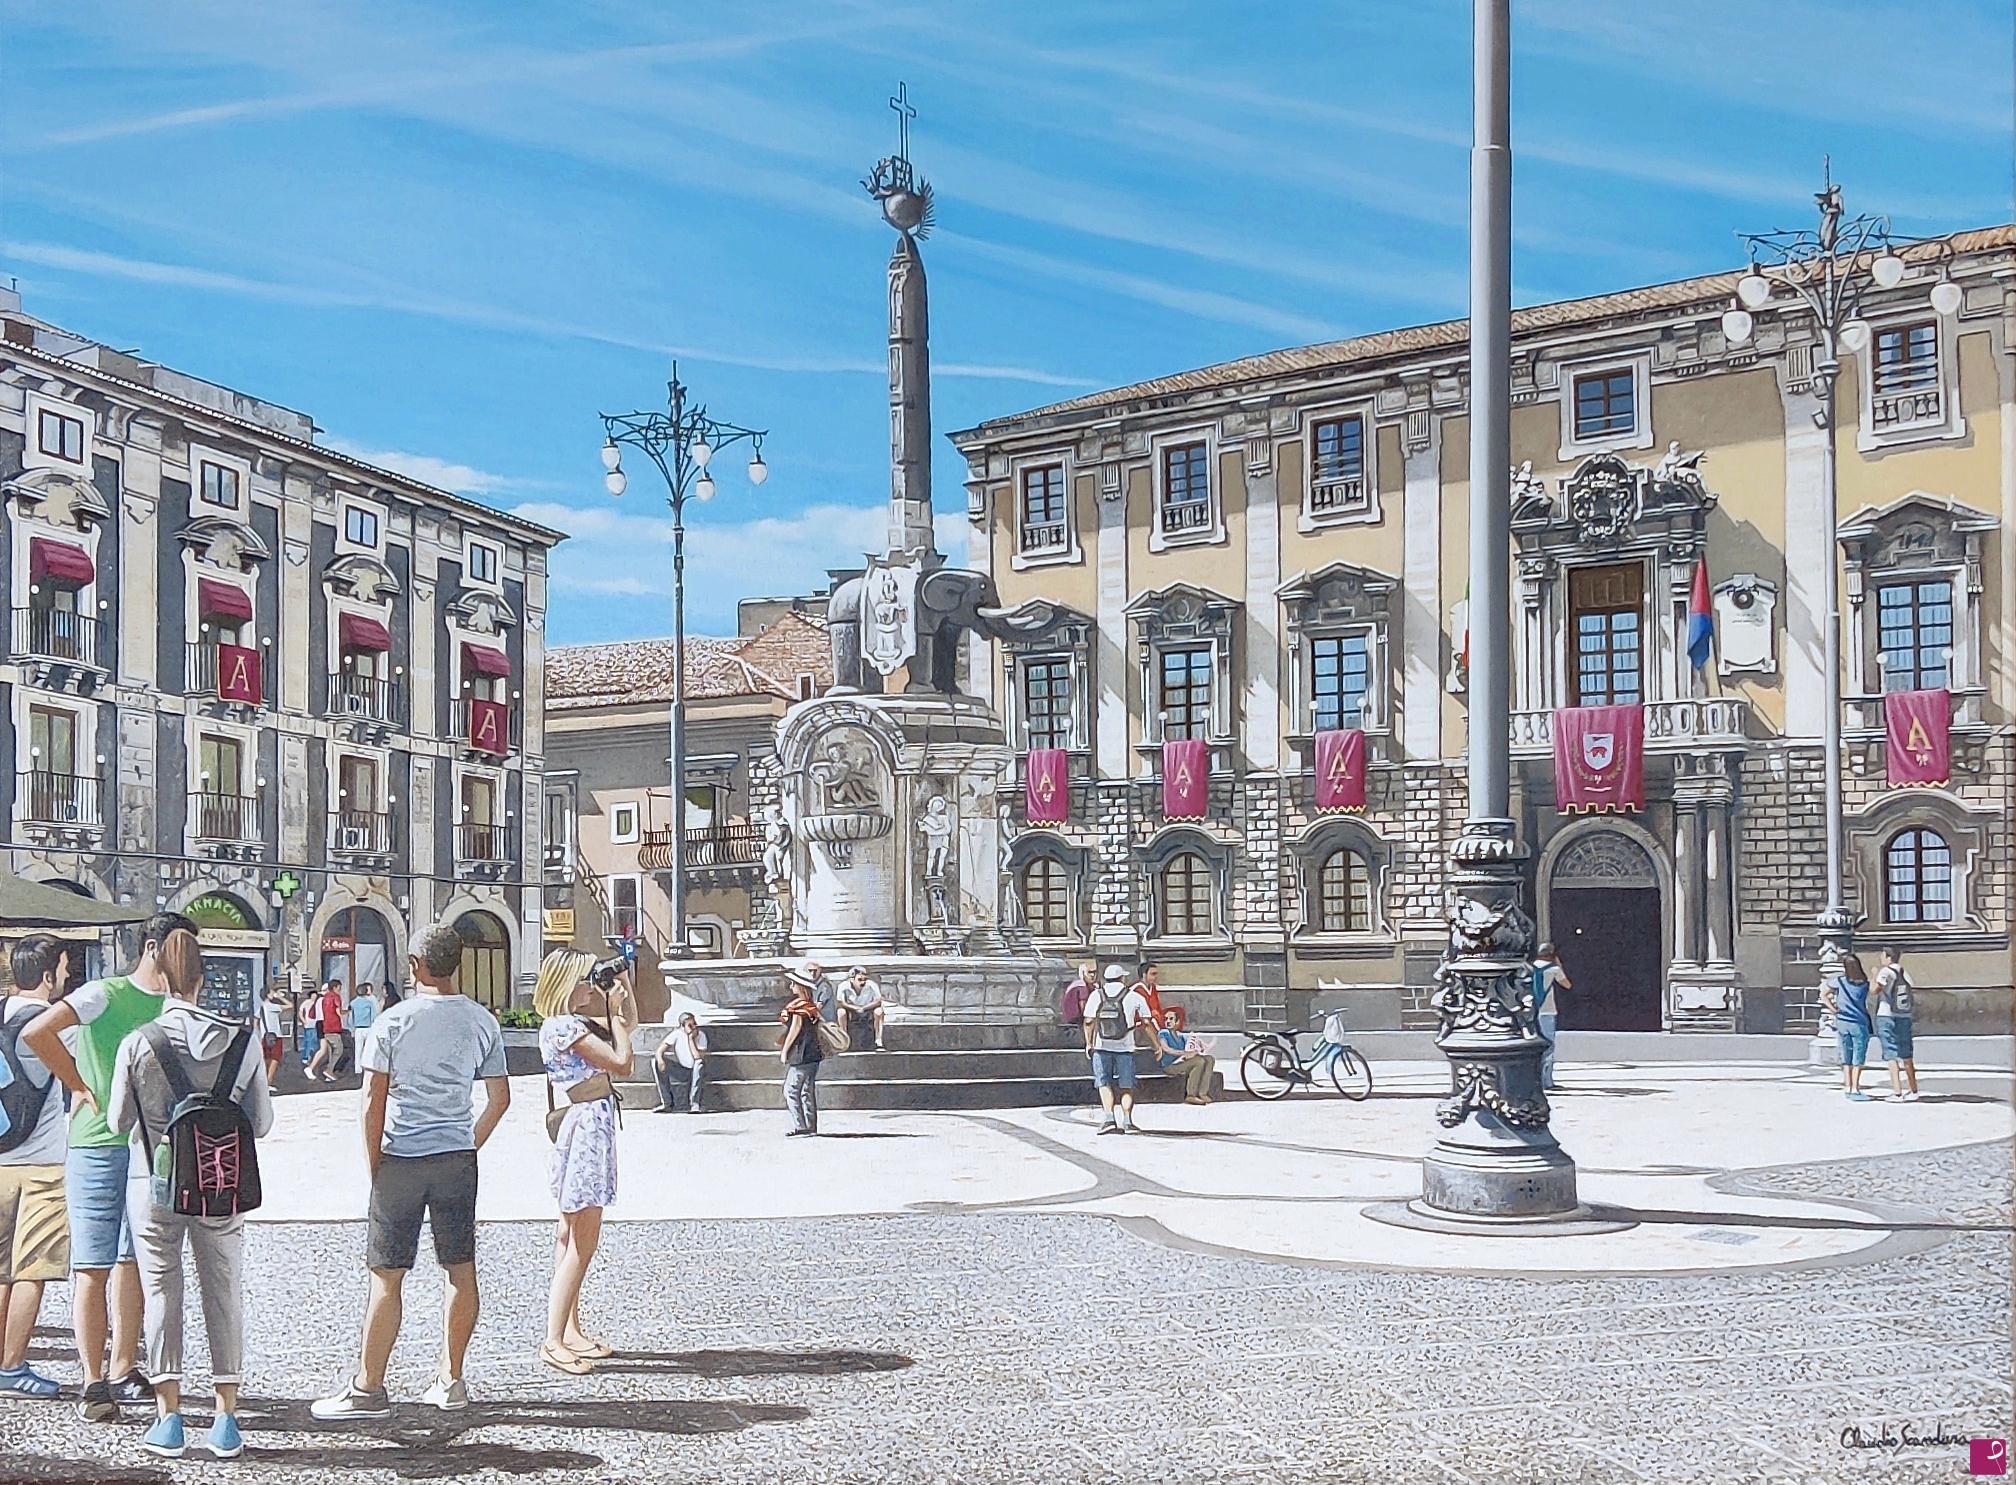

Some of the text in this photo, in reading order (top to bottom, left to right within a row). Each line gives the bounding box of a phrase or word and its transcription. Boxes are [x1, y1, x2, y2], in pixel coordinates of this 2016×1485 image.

[227, 655, 250, 691] A
[477, 709, 497, 742] A
[1906, 715, 1934, 751] A
[1172, 761, 1193, 785] A
[1327, 750, 1353, 780] A
[1036, 770, 1056, 792] A
[184, 898, 242, 924] ARMACIA
[1840, 1421, 1899, 1449] Claudio
